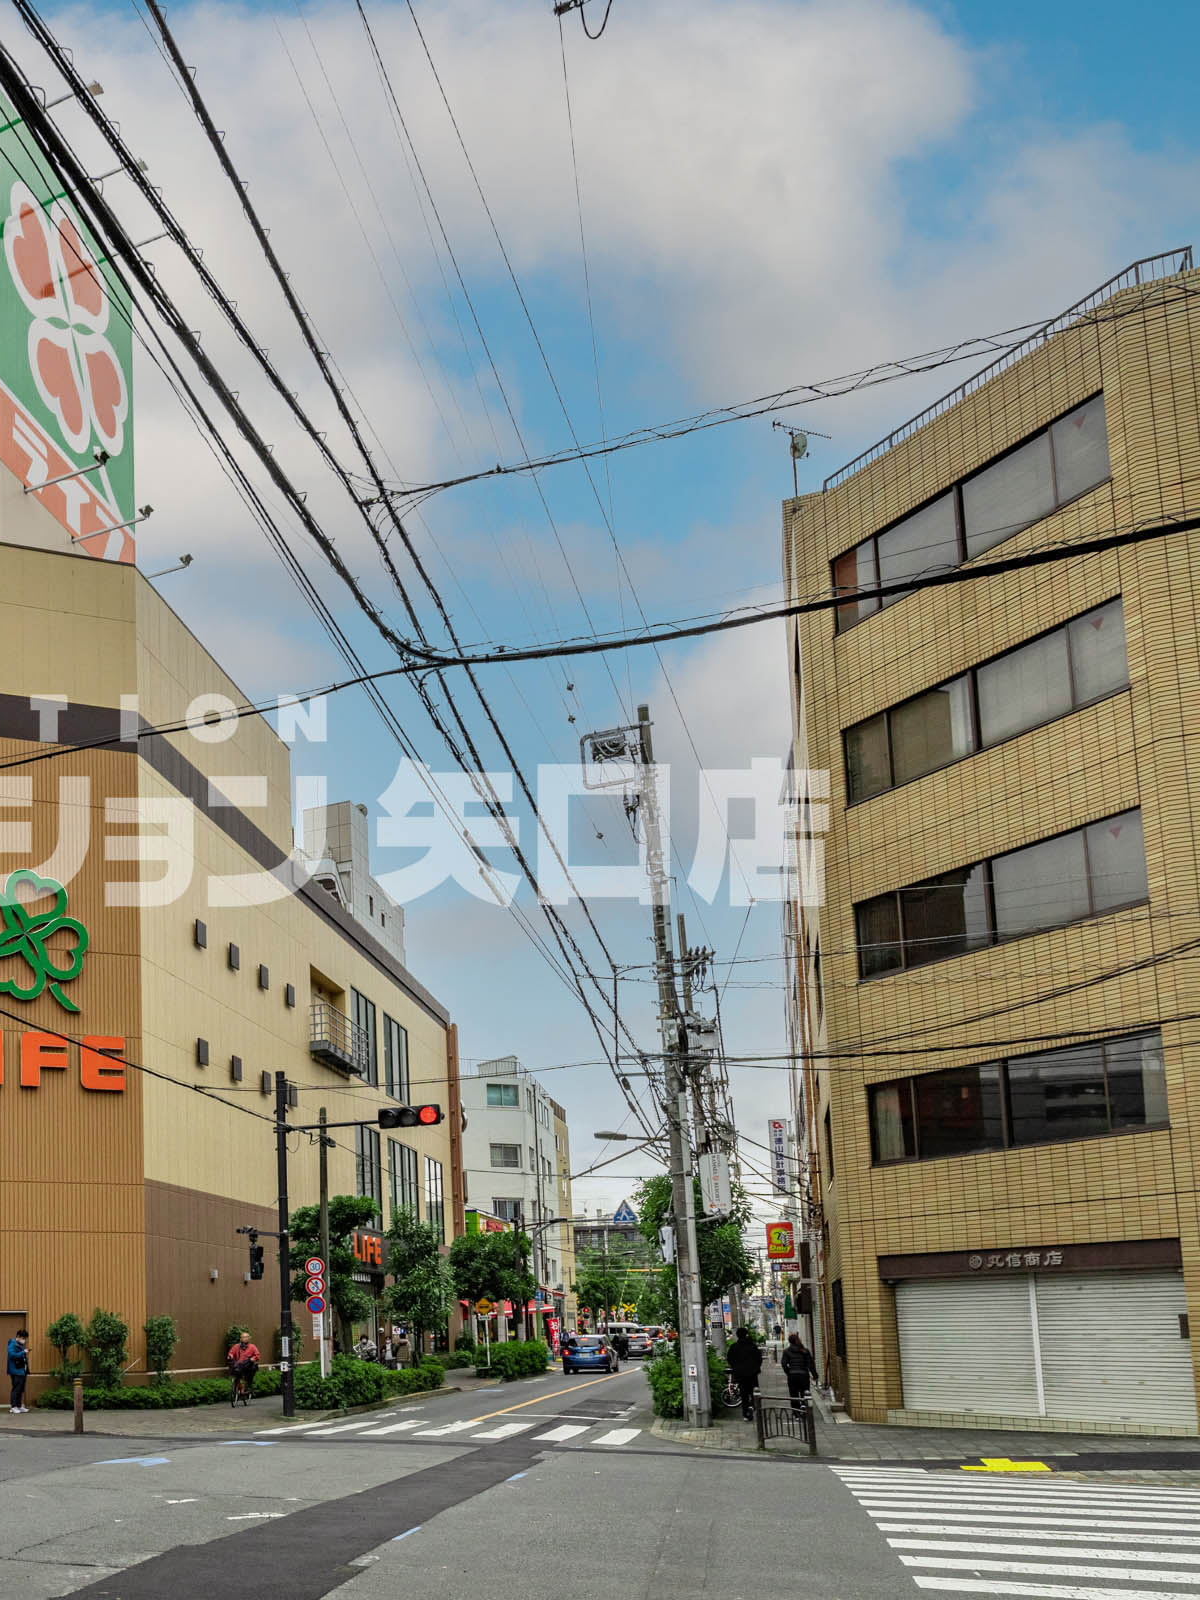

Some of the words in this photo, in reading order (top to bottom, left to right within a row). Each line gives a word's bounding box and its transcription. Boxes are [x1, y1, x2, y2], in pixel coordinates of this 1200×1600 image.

[13, 412, 125, 562] ライフ
[353, 1231, 382, 1265] LIFE
[309, 1262, 321, 1272] 30
